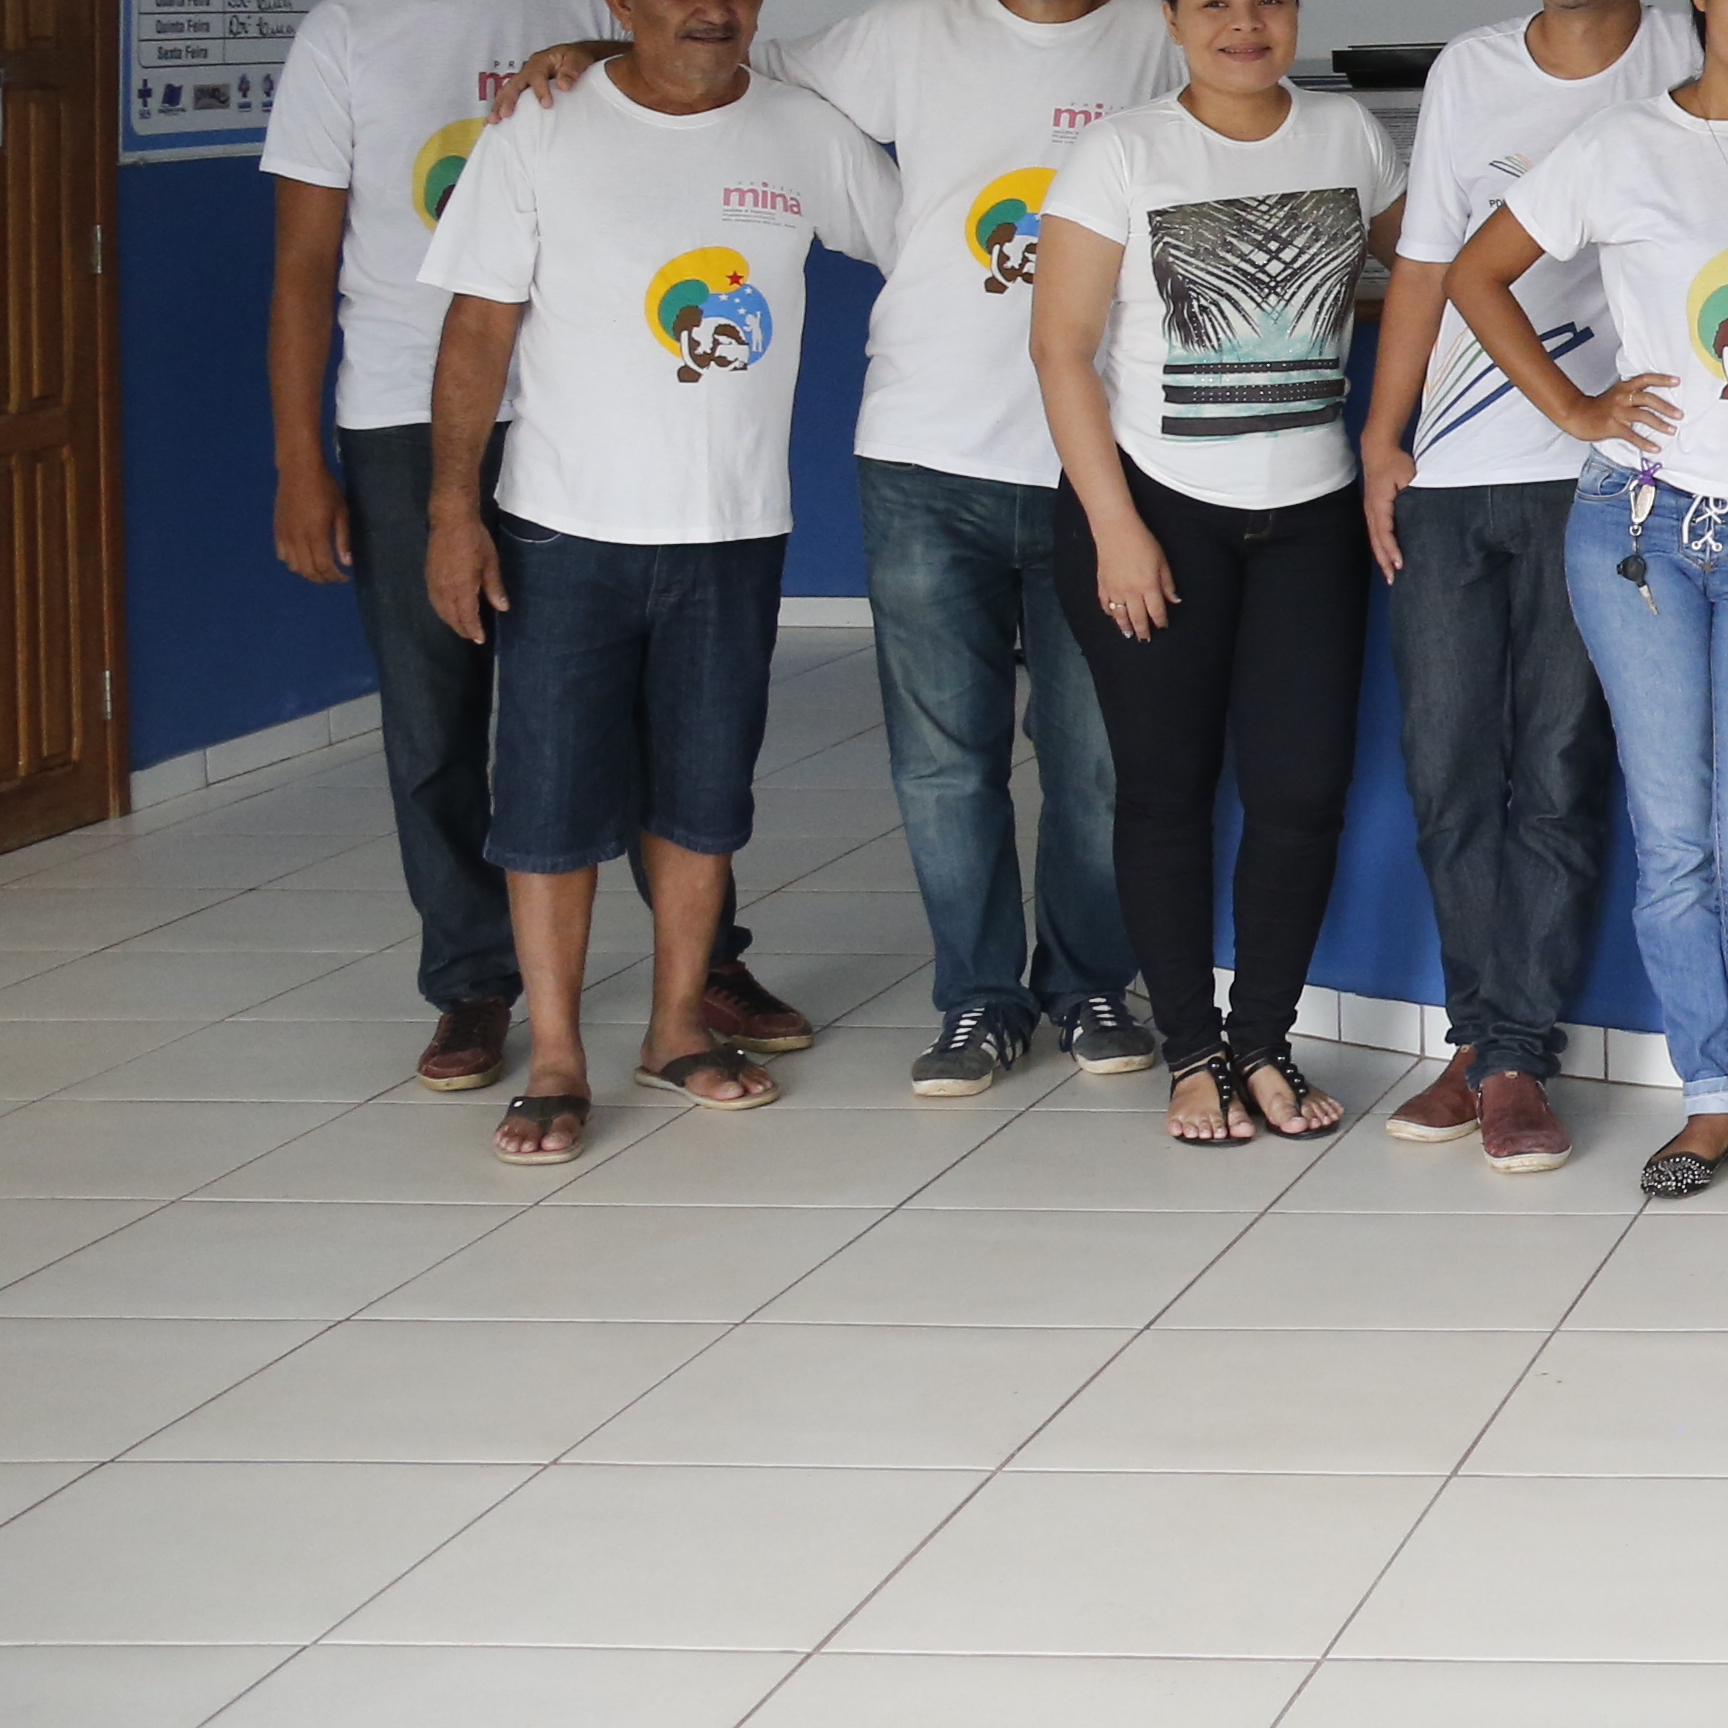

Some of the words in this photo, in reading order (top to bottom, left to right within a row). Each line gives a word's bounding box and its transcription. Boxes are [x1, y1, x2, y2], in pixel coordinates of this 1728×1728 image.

[187, 20, 210, 33] Feira
[185, 47, 208, 59] Feira
[723, 181, 803, 216] mina
